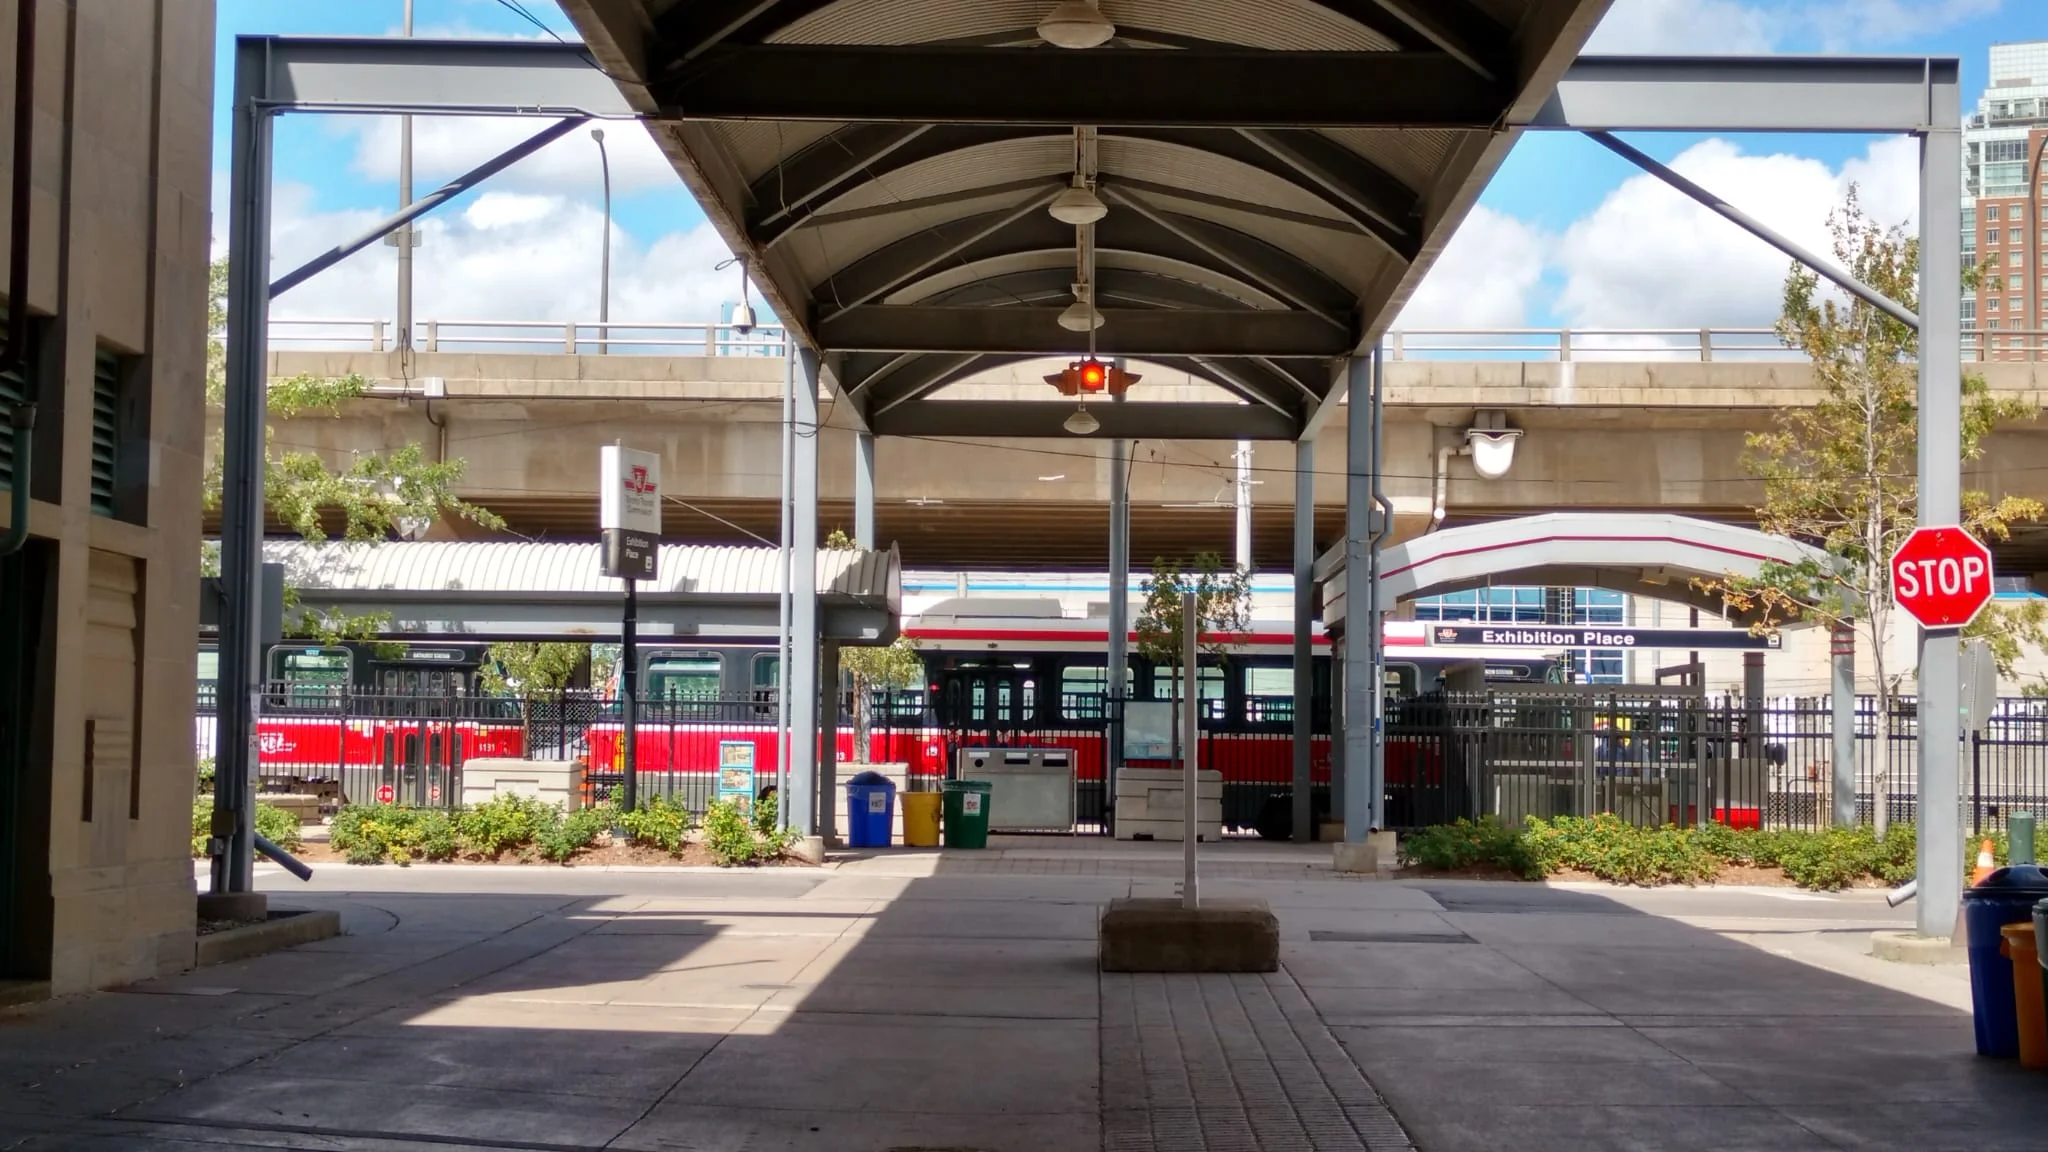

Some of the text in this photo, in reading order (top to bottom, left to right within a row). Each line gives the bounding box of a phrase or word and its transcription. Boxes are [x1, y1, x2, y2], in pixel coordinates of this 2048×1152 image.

[1898, 556, 1984, 598] STOP
[1482, 630, 1635, 645] Exhibition Place
